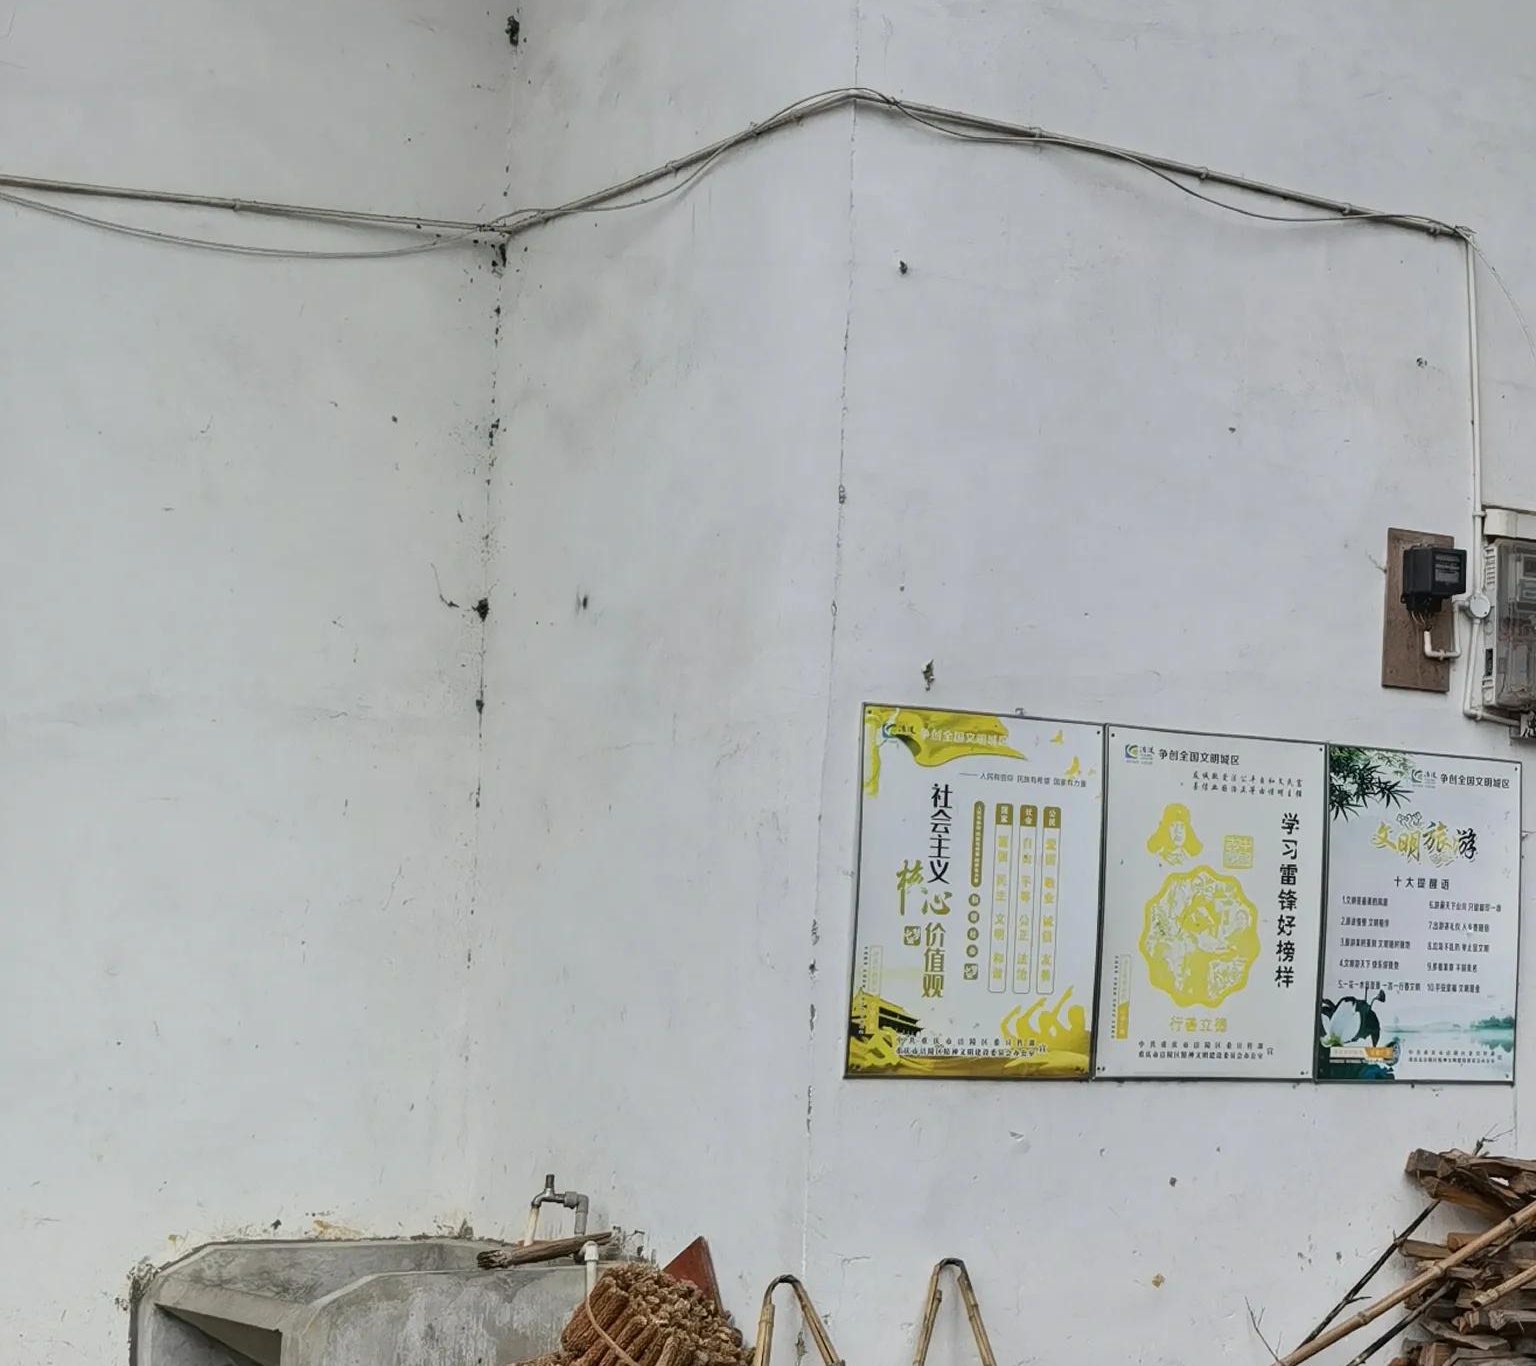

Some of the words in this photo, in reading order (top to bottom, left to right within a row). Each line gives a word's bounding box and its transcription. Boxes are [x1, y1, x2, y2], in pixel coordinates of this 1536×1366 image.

[1159, 748, 1240, 766] 争创全国文明城区
[1440, 774, 1510, 789] 争创全国文明城区
[927, 783, 953, 885] 社会主义
[1371, 820, 1479, 862] 文明旅游
[1275, 812, 1299, 988] 学习雷锋好榜样
[1393, 875, 1450, 891] 十大提醒语
[922, 922, 947, 998] 价值观
